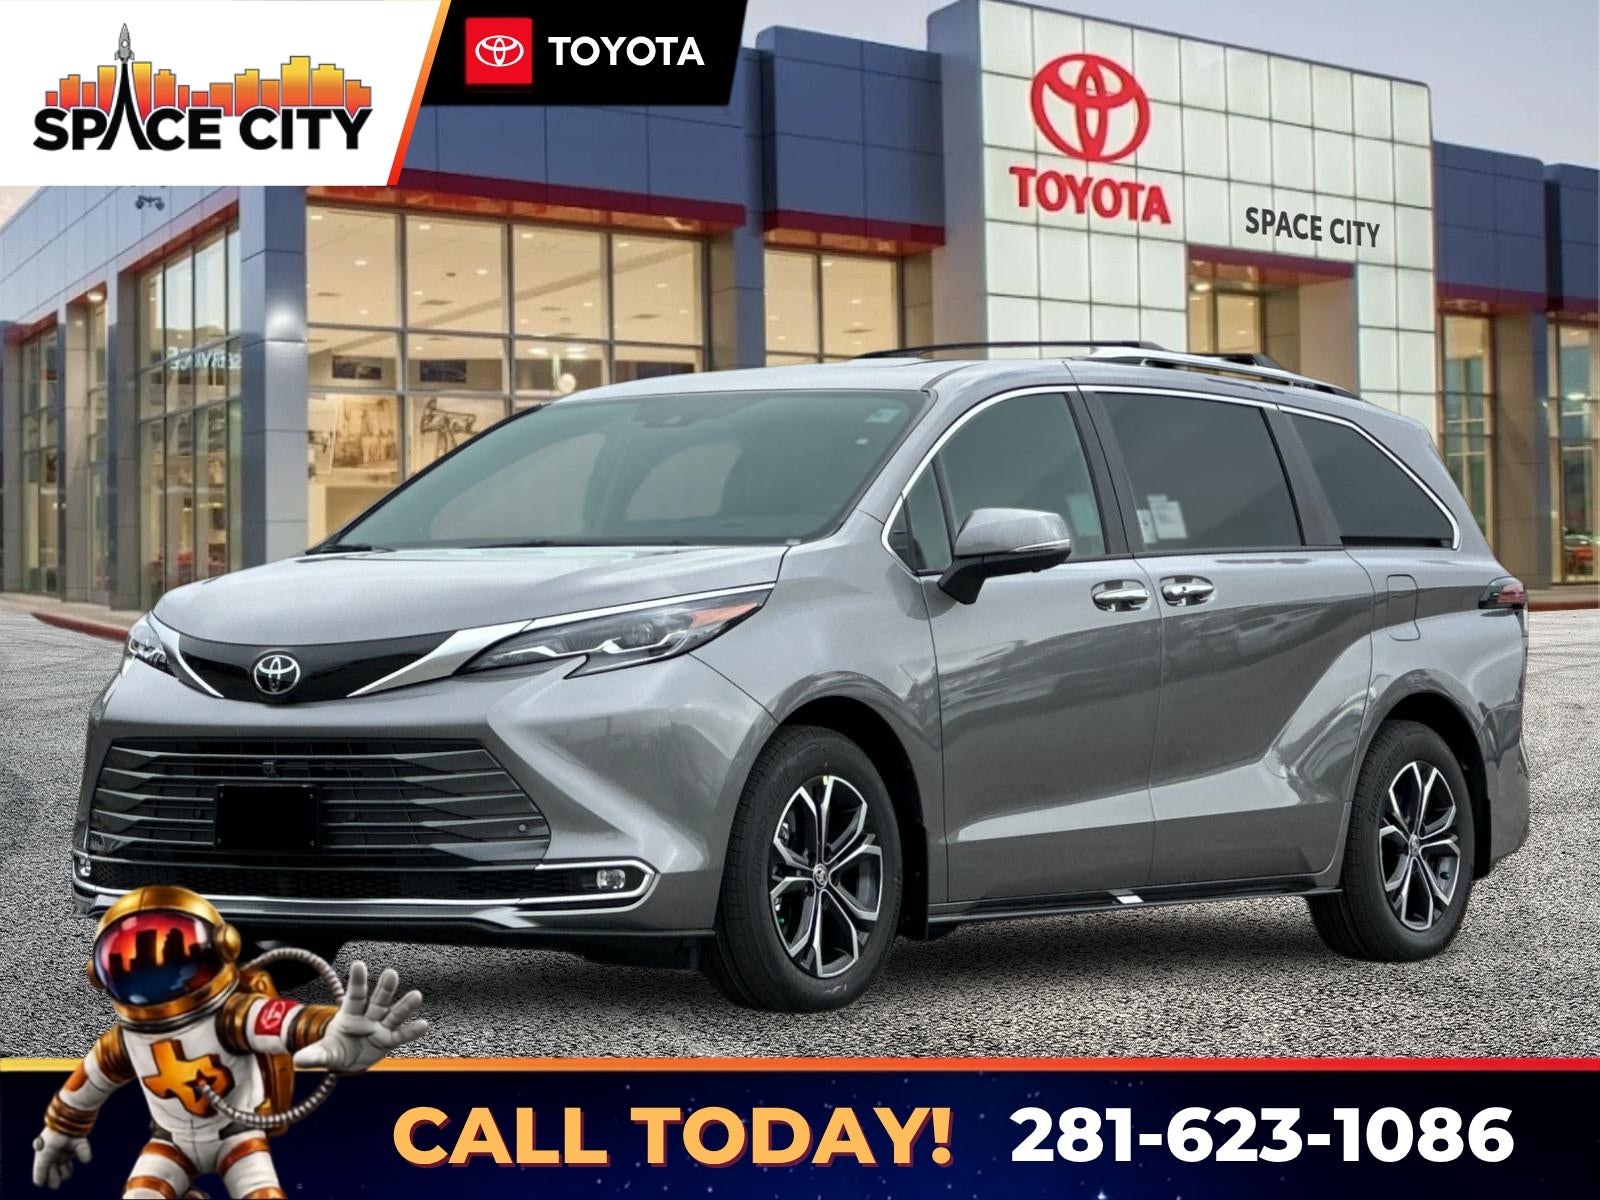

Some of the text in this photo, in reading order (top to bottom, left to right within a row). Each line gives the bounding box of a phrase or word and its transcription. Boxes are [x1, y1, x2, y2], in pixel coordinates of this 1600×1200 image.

[1009, 166, 1171, 224] TOYOTA
[1245, 207, 1381, 248] SPACE CITY
